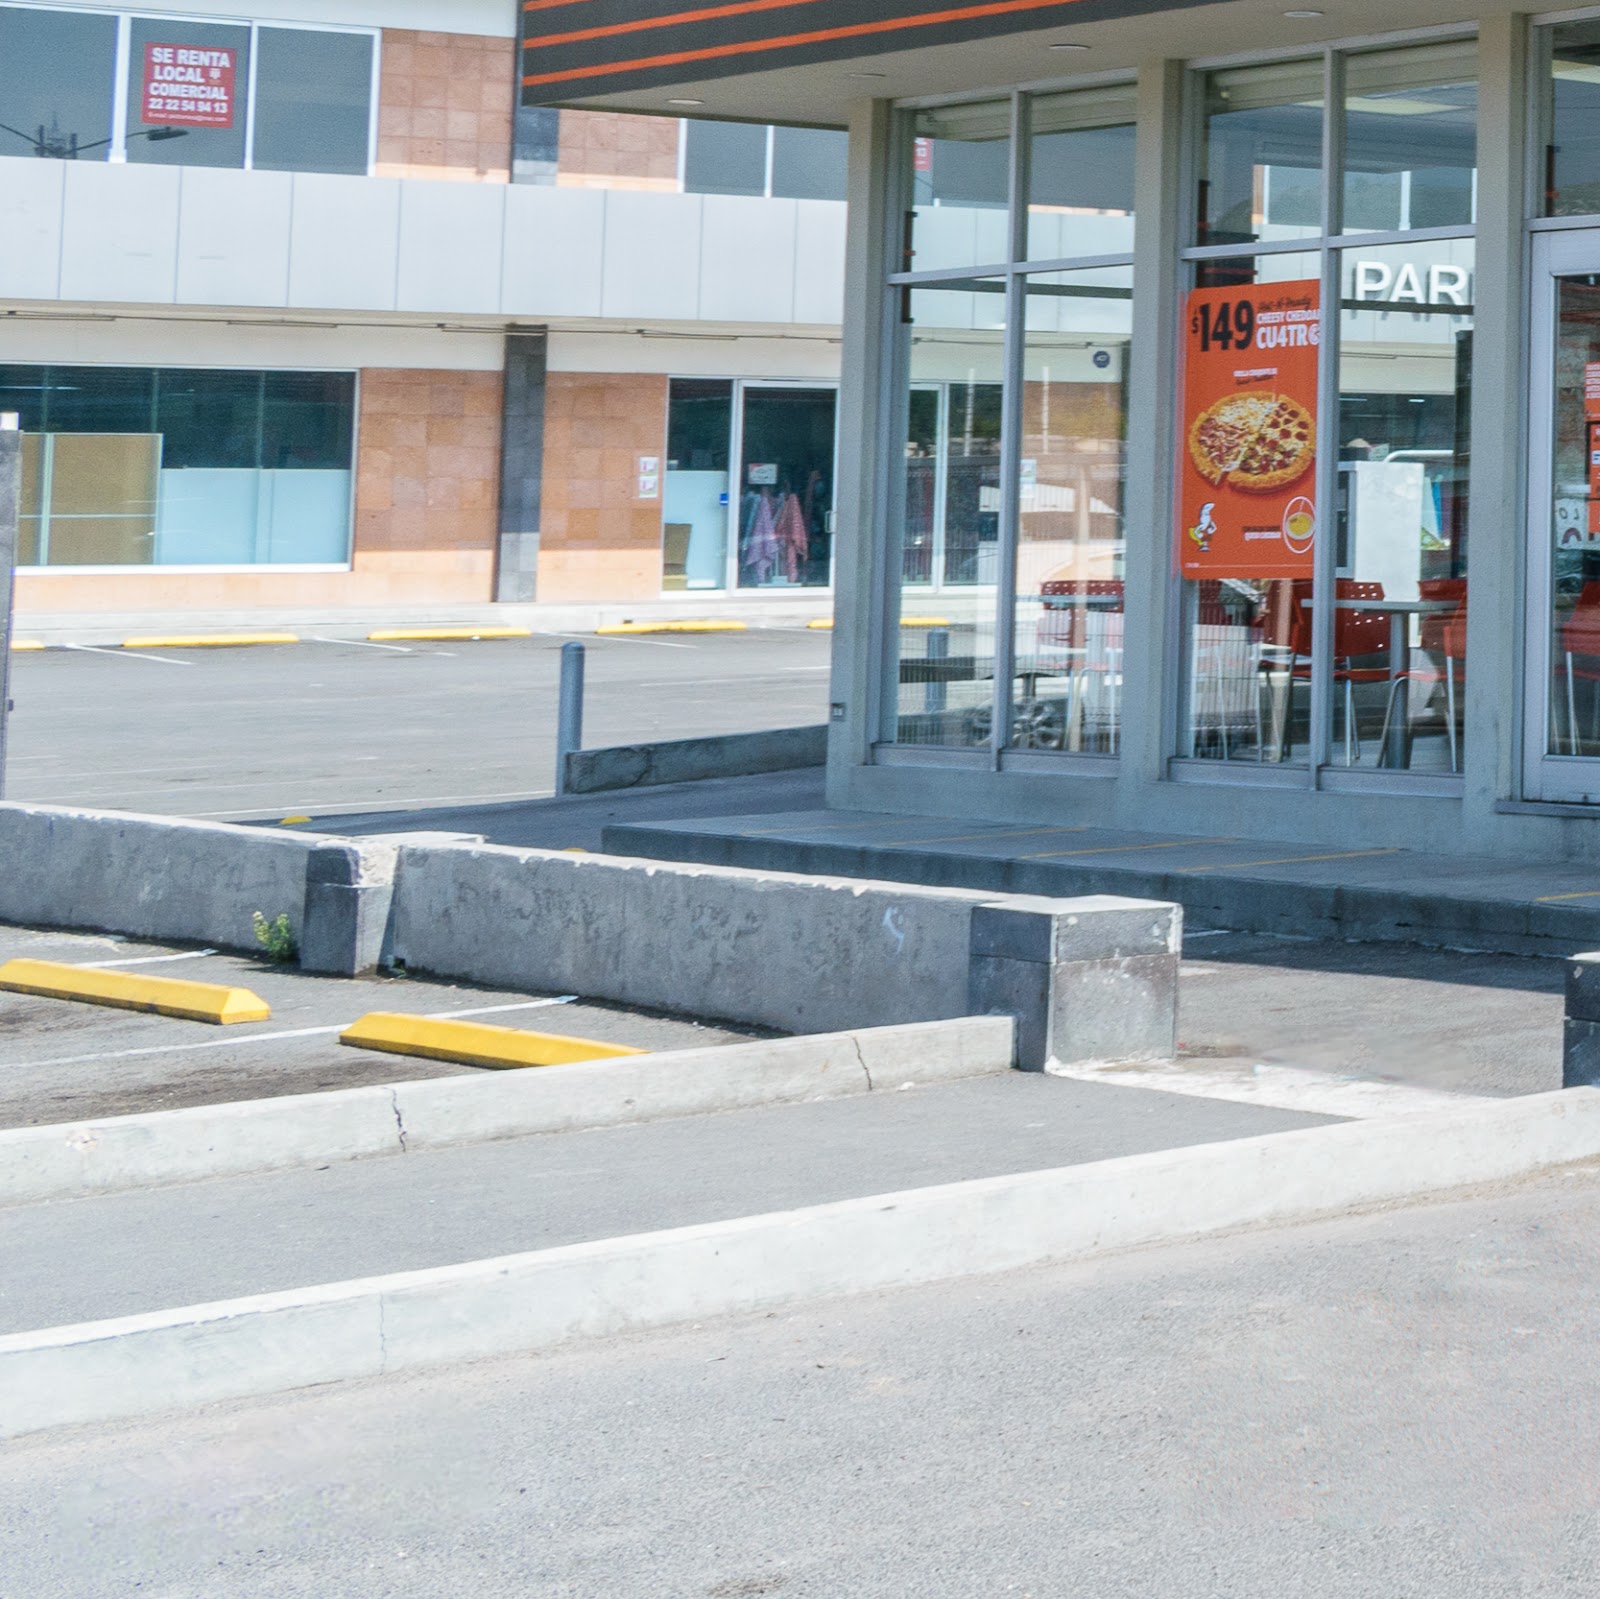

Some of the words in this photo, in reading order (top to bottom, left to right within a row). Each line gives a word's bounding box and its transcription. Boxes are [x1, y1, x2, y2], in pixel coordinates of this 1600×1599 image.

[152, 47, 174, 64] SE
[177, 49, 231, 68] RENTA
[153, 65, 205, 83] LOCAL
[149, 82, 229, 100] COMERCIAL
[148, 98, 163, 109] 22
[165, 99, 180, 110] 22
[181, 100, 195, 111] 54
[213, 102, 228, 113] 13
[1192, 299, 1254, 352] $149
[1256, 311, 1284, 325] CHEESY
